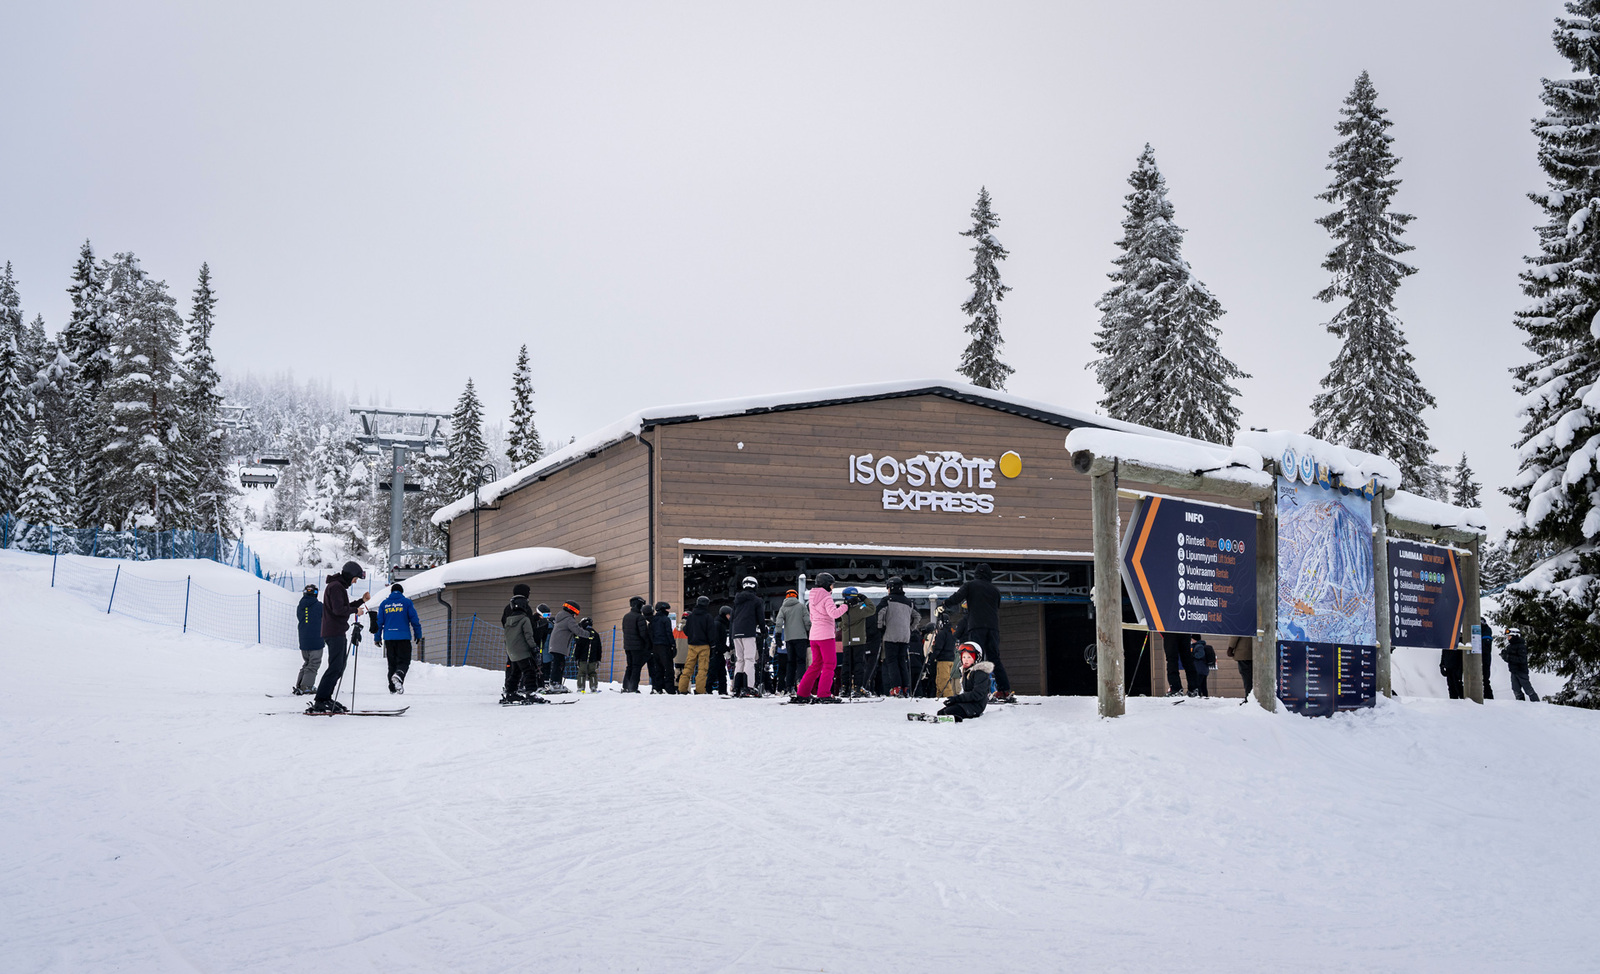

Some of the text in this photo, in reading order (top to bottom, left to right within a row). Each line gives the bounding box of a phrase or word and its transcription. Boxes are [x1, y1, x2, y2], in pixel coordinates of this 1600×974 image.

[882, 488, 995, 514] EXPRESS
[1185, 512, 1204, 523] INFO
[1185, 534, 1205, 547] Rinteet
[1185, 550, 1218, 564] Lipunmyynti
[1399, 549, 1423, 561] LUMIMAA
[1186, 565, 1216, 577] Vuokraamo
[1186, 580, 1213, 592] Ravintolat
[1187, 595, 1219, 607] Ankkurihissi
[1187, 610, 1208, 623] Ensiapu
